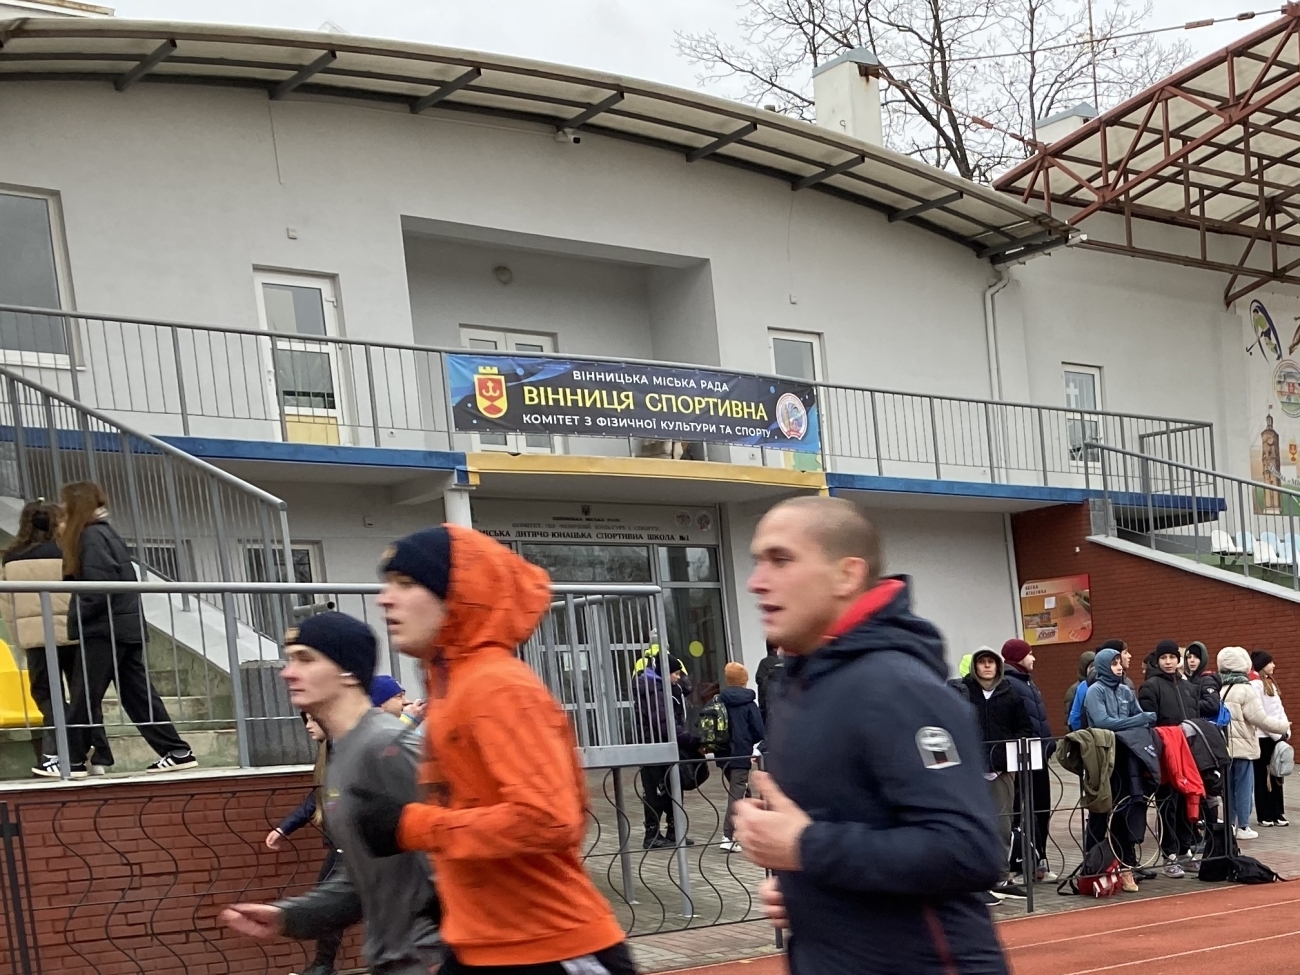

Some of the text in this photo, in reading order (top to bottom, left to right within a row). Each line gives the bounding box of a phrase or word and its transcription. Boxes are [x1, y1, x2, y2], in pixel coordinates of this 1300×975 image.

[573, 370, 730, 393] ВІННИЦЬКА МІСЬКА РАДА
[523, 385, 635, 413] ВІННИЦЯ
[645, 393, 769, 421] СПОРТИВНА
[523, 413, 771, 438] КОМІТЕТ З ФІЗИЧНОЇ КУЛЬТУРИ ТА СПОРТУ
[596, 532, 643, 540] СПОРТИВНА
[647, 533, 675, 541] ШКОЛА
